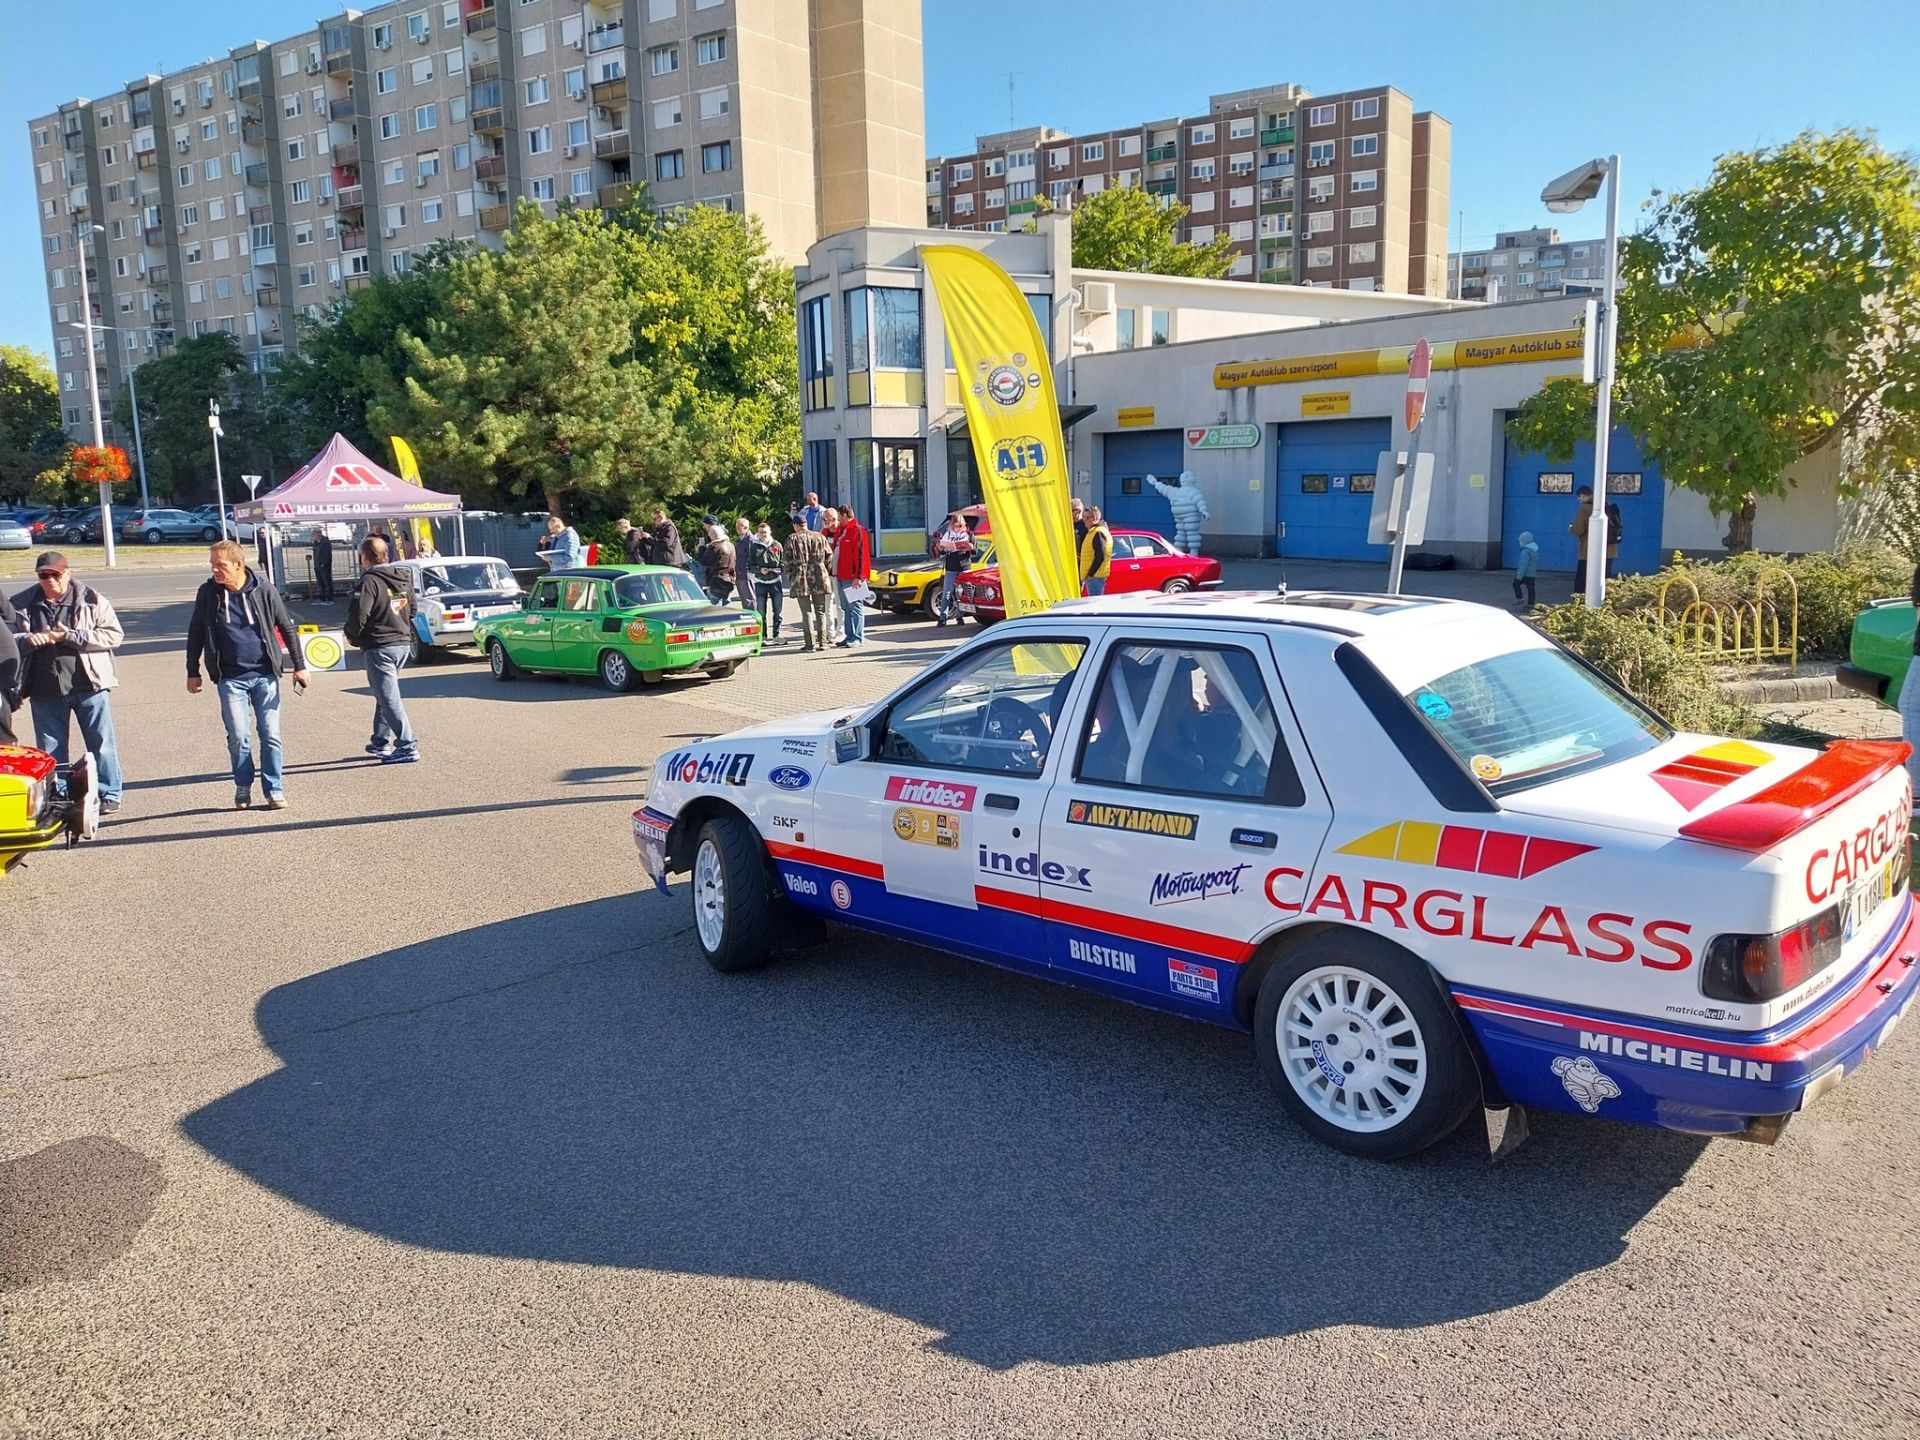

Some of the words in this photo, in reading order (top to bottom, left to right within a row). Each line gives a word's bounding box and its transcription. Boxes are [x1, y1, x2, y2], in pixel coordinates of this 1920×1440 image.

[1465, 346, 1506, 359] Magyar
[1509, 339, 1561, 354] Autóklub
[1220, 371, 1248, 381] Magyar
[1250, 366, 1288, 378] Autóklub
[1220, 436, 1253, 445] PARTNER
[297, 504, 351, 514] MILLERS
[352, 503, 380, 513] OILS
[666, 753, 731, 785] Mobil
[775, 767, 803, 786] Ford
[899, 779, 966, 808] infotec
[773, 815, 799, 828] SKF
[922, 820, 930, 833] 9
[1087, 805, 1194, 836] METABOND
[979, 844, 1092, 887] index
[784, 873, 818, 896] Valeo
[1150, 862, 1252, 905] Motorsport
[1263, 867, 1693, 971] CARGLASS
[1069, 938, 1137, 974] BILSTEIN
[1172, 971, 1193, 985] PARTS
[1177, 984, 1212, 1000] Motorcraft
[1665, 1004, 1741, 1022] matricakell.hu
[1579, 1031, 1773, 1082] MICHELIN
